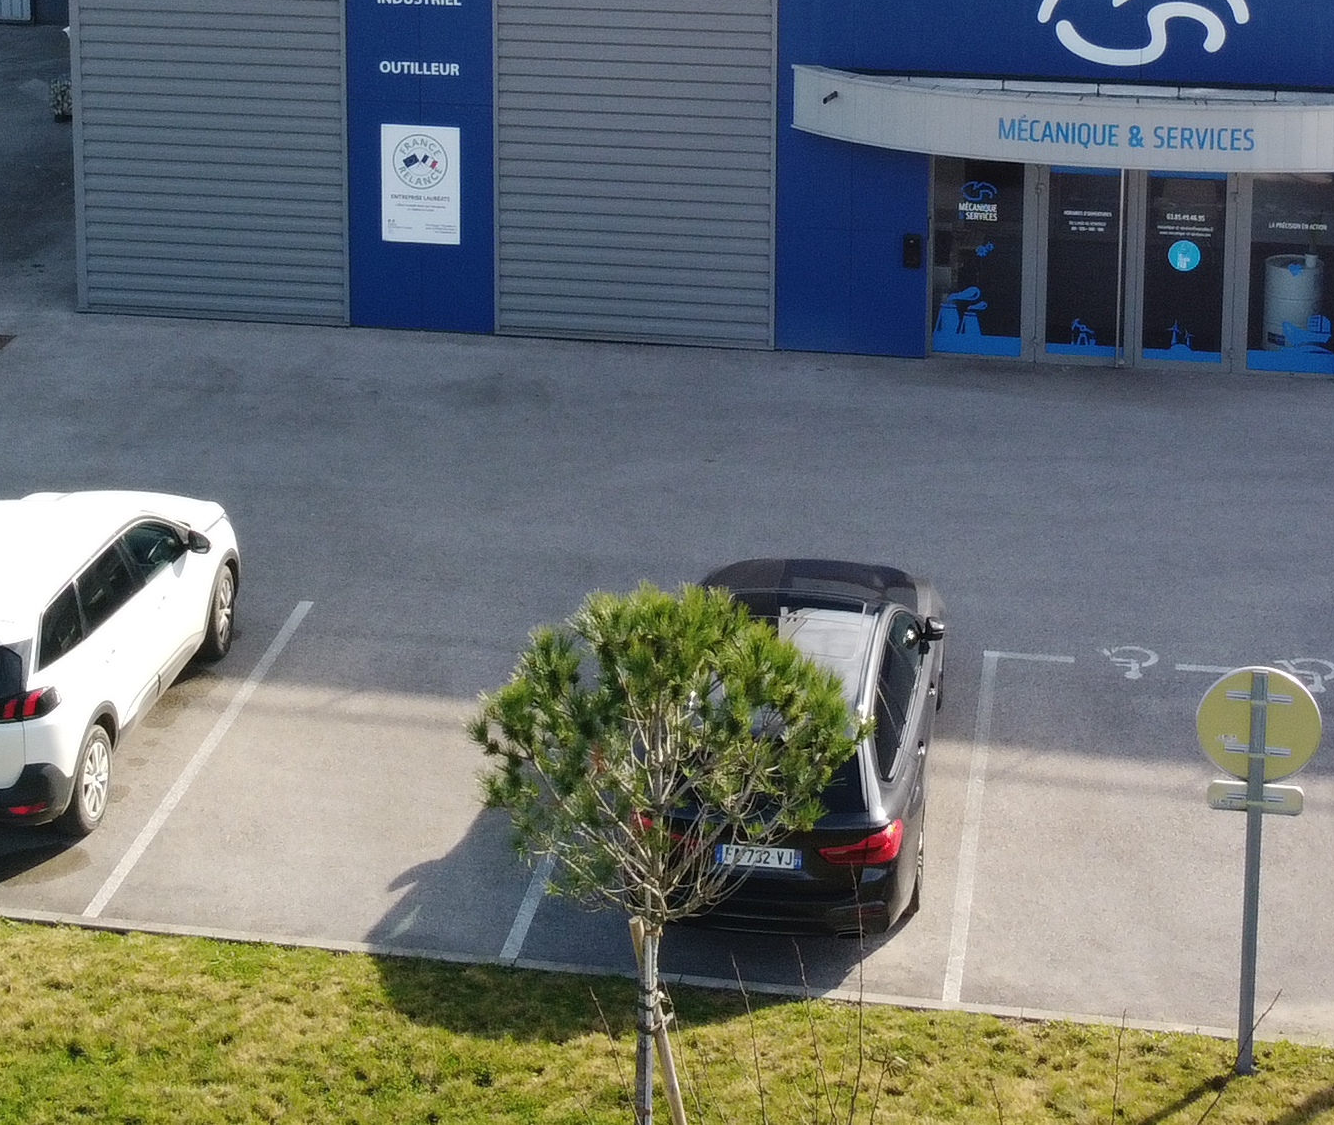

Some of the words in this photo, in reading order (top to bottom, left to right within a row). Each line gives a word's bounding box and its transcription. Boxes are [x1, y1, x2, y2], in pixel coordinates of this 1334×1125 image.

[379, 60, 460, 76] OUTILLEUR
[998, 114, 1120, 149] MÉCANIQUE
[1127, 125, 1145, 148] &
[1153, 125, 1255, 152] SERVICES
[399, 138, 442, 156] FRANCE
[398, 166, 443, 186] RELANCE
